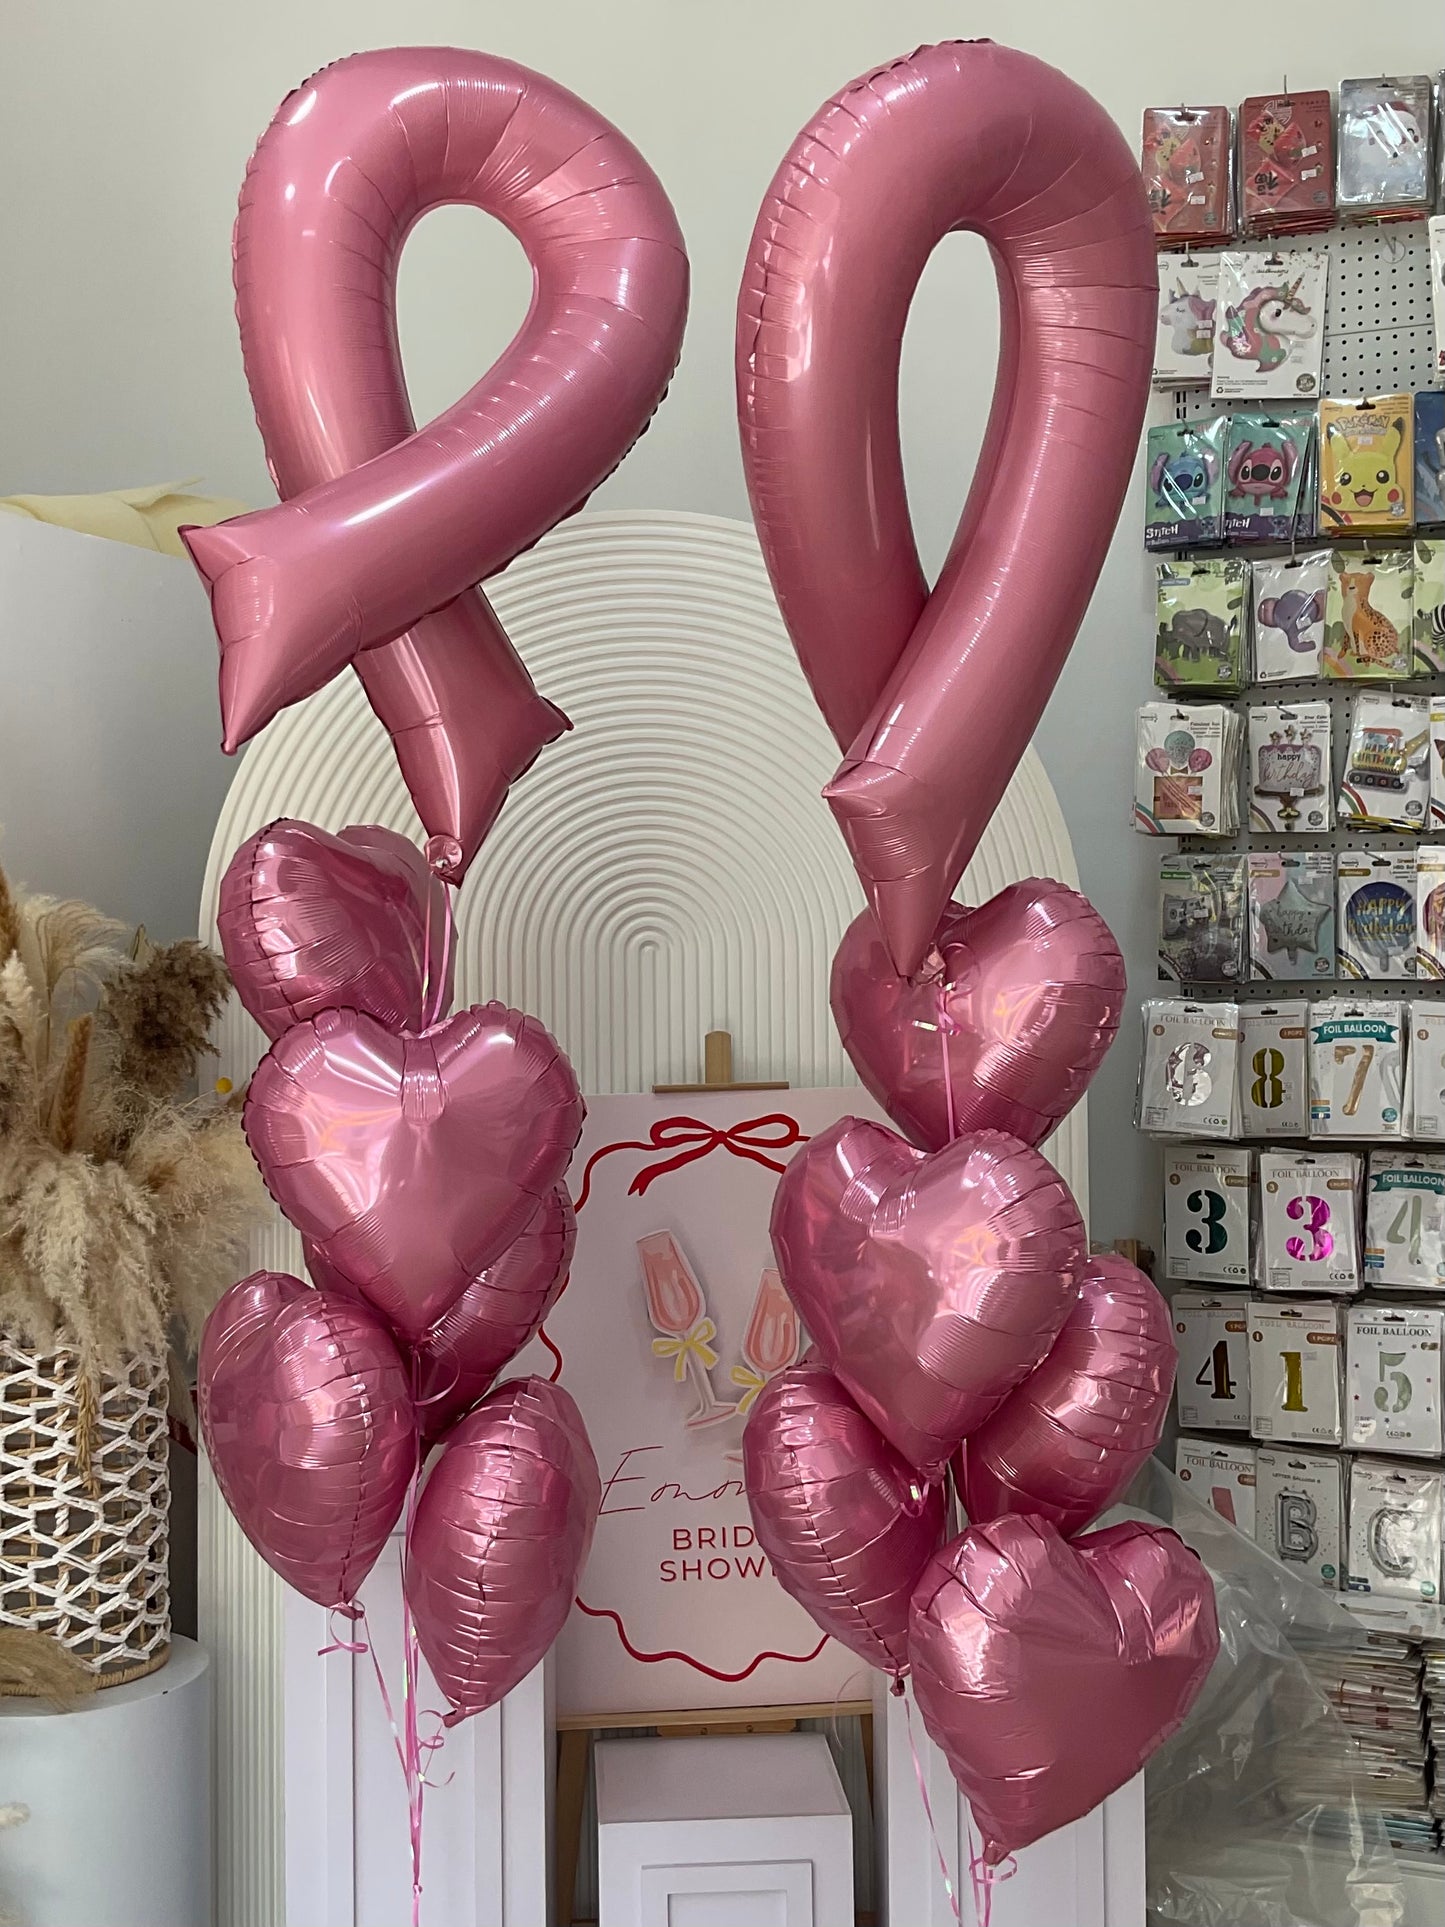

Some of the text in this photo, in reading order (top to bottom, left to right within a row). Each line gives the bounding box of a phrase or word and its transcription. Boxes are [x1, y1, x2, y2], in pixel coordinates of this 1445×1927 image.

[1277, 753, 1301, 762] happy
[1262, 761, 1314, 790] birthday
[1323, 1023, 1387, 1034] FOIL BALLOON
[1250, 1047, 1285, 1109] 8
[1334, 1044, 1375, 1116] 7
[1175, 1163, 1194, 1173] FOIL
[1272, 1169, 1340, 1179] FOIL BALLOON
[1382, 1173, 1401, 1183] FOIL
[1185, 1189, 1228, 1255] 3
[1285, 1195, 1334, 1261] 3
[1386, 1195, 1423, 1266] 4
[1356, 1326, 1432, 1337] FOIL BALLOON
[1195, 1340, 1237, 1400] 4
[1279, 1351, 1309, 1412] 1
[1374, 1351, 1412, 1413] 5
[1186, 1456, 1206, 1468] FOIL
[1209, 1459, 1252, 1473] BALLOON
[673, 1526, 760, 1550] BRID
[1275, 1487, 1319, 1562] B
[660, 1556, 777, 1582] SHOW
